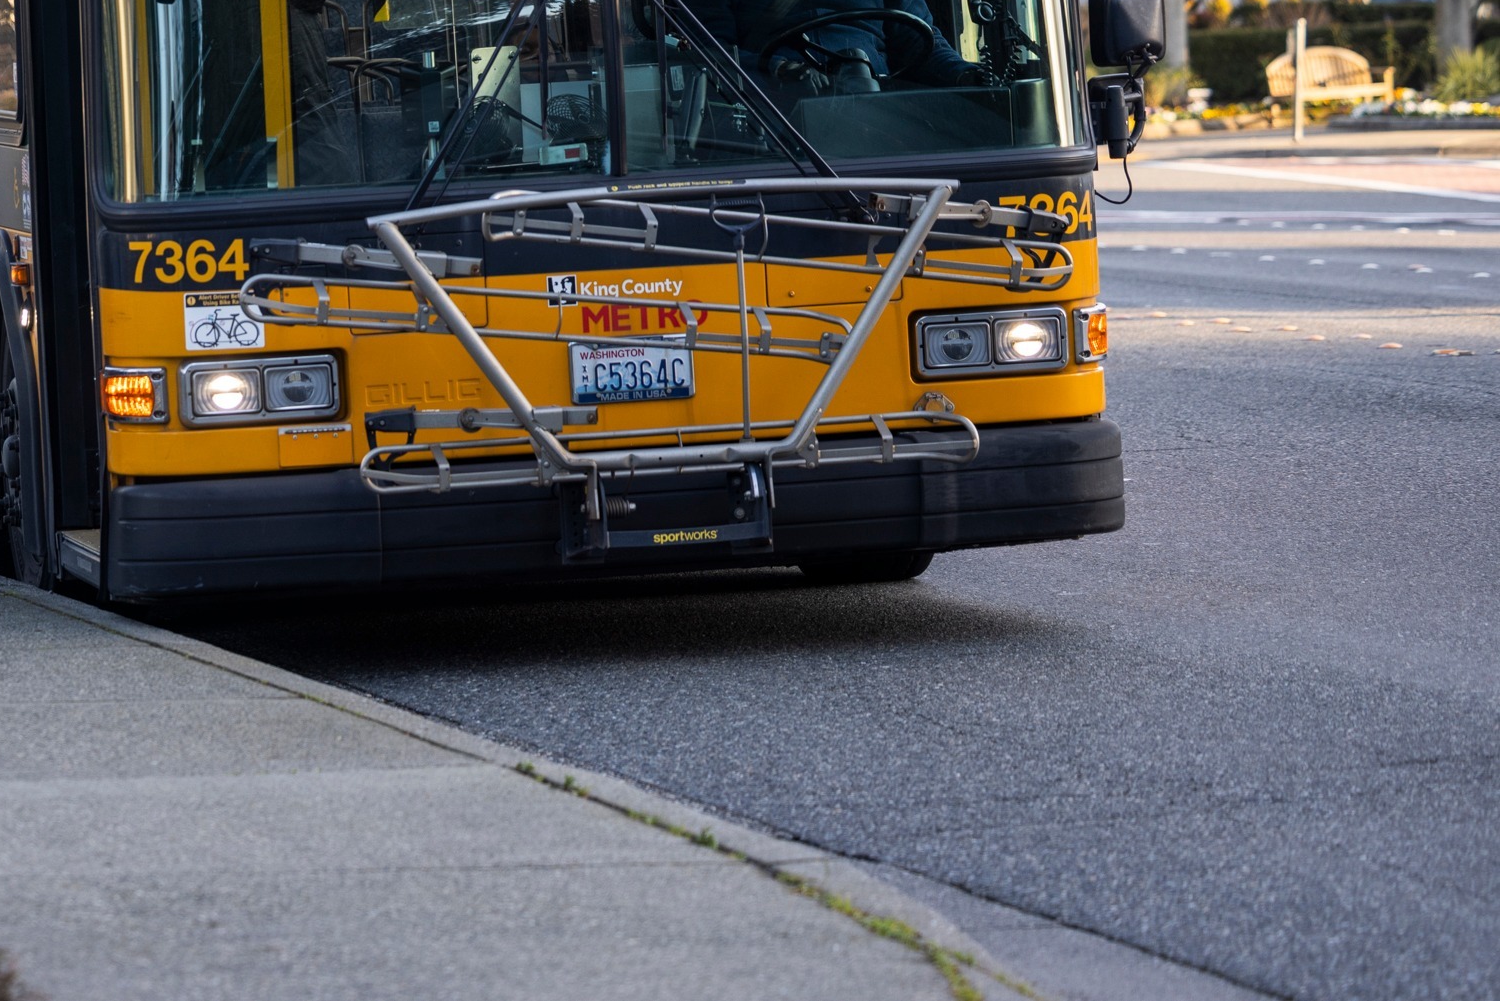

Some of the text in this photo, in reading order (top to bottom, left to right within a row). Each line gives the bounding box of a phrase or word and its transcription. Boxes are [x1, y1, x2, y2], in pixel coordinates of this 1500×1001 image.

[128, 238, 250, 284] 7364
[580, 279, 683, 298] King County
[581, 299, 708, 333] METRO
[579, 348, 645, 360] WASHINGTON
[594, 358, 685, 392] C5364C
[365, 378, 481, 407] GILLIG
[601, 389, 668, 401] MADE IN USA
[653, 529, 718, 544] sportworks
